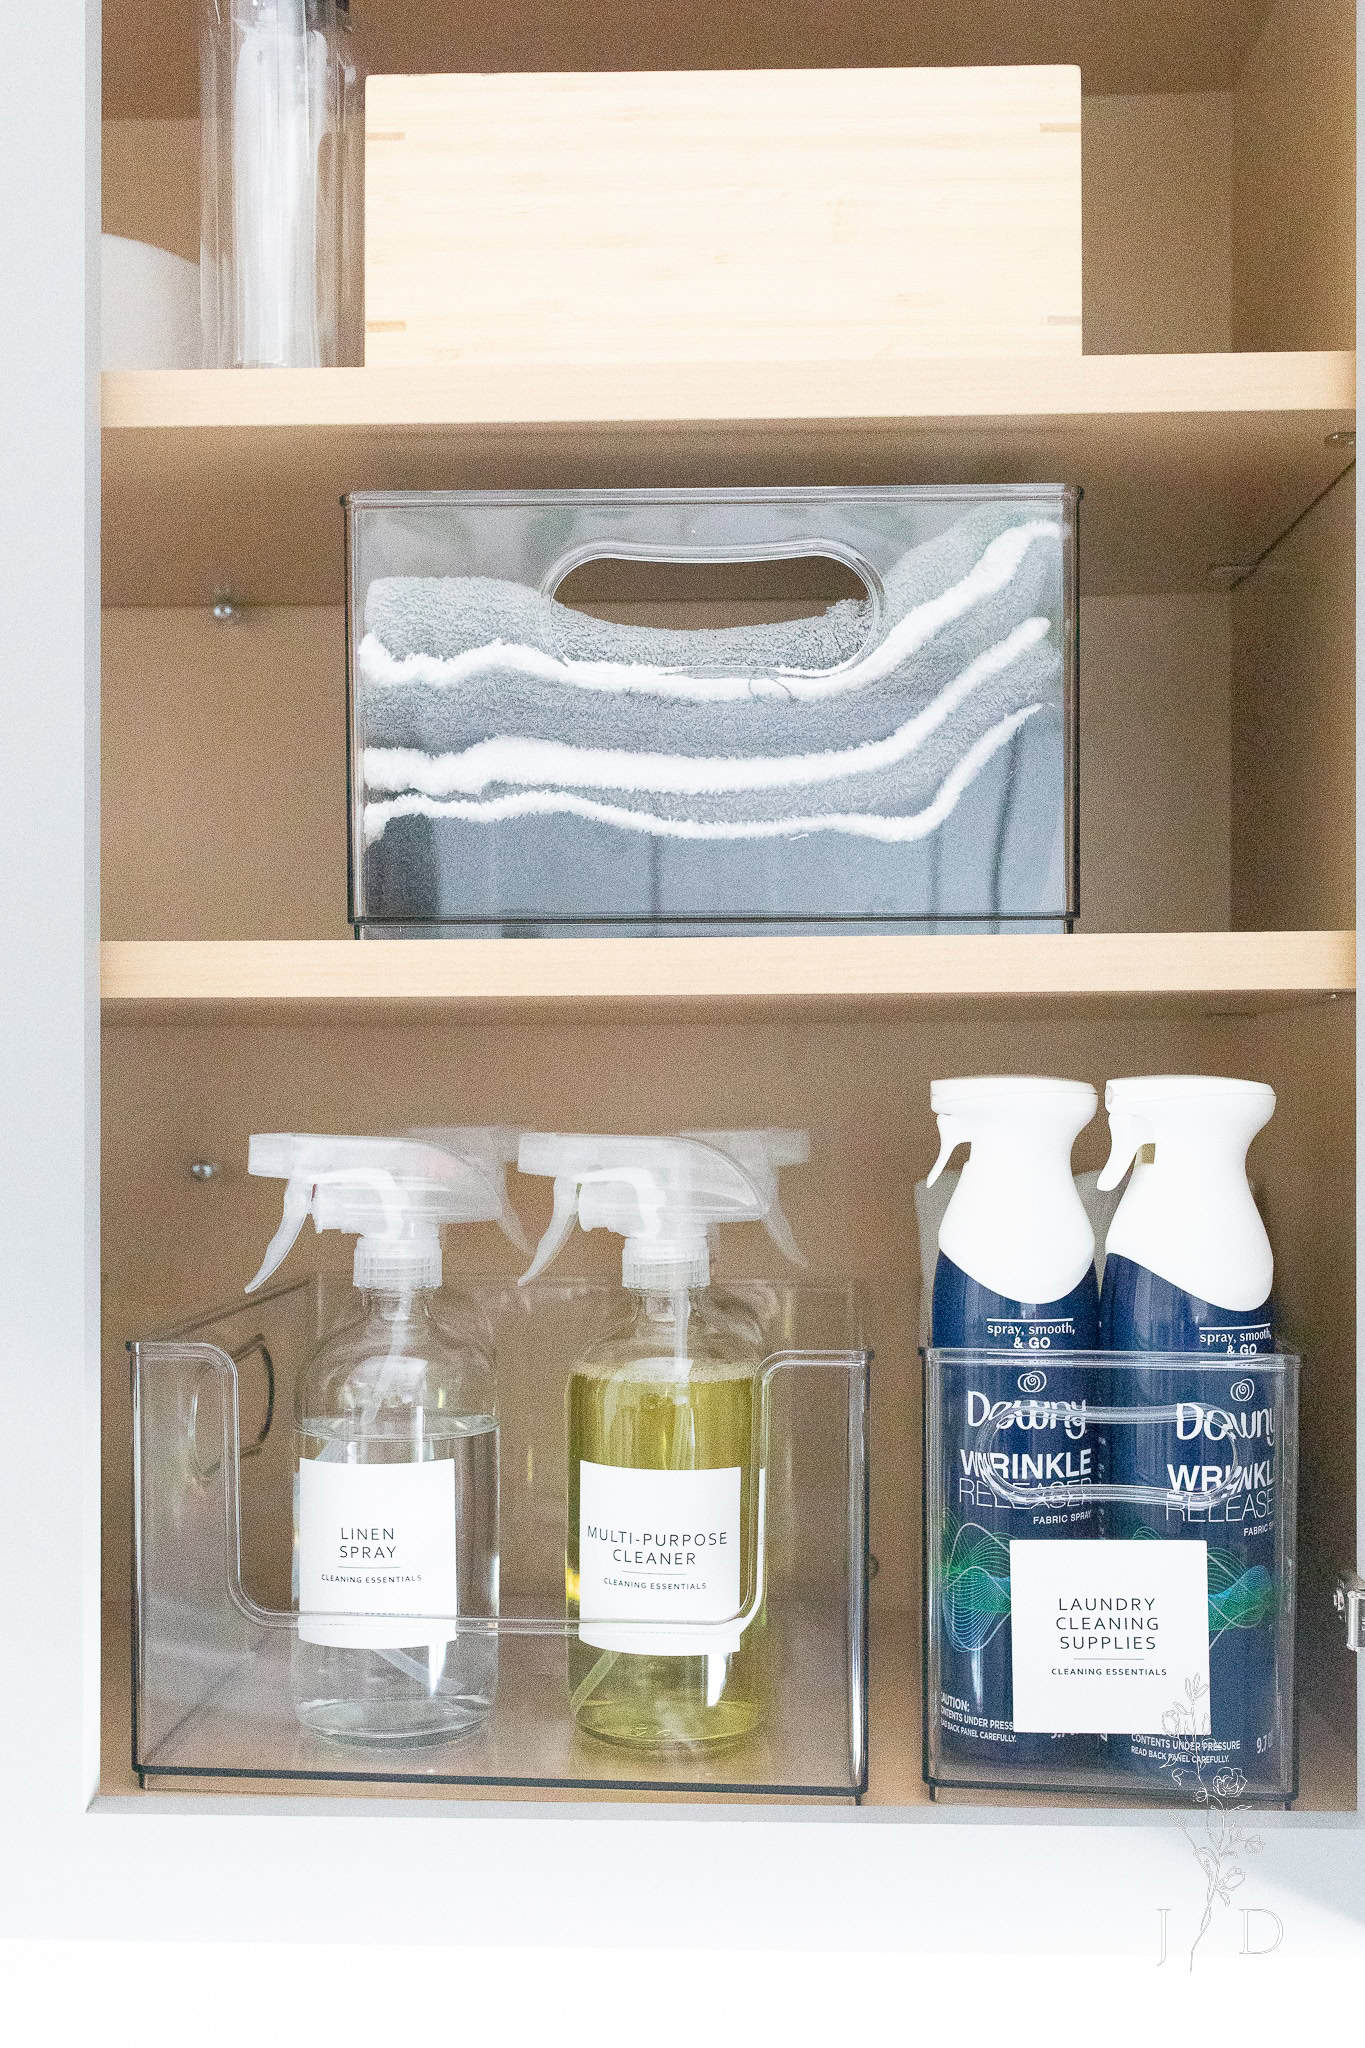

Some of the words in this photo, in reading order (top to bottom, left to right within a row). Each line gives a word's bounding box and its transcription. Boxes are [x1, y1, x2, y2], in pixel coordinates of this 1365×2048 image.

[987, 1324, 1025, 1337] spray,
[1028, 1321, 1075, 1335] smooth,
[1013, 1338, 1023, 1349] &
[1028, 1336, 1051, 1349] GO
[1200, 1333, 1237, 1346] spray,
[1239, 1327, 1272, 1342] smooth,
[1226, 1344, 1235, 1355] &
[1239, 1343, 1257, 1355] GO
[967, 1391, 1087, 1440] Downy
[959, 1448, 1092, 1480] WRINKLE
[1033, 1515, 1068, 1525] FABRIC
[1070, 1509, 1092, 1522] SPRAY
[341, 1527, 394, 1541] LINEN
[587, 1525, 727, 1547] MULTI-PURPOSE
[1243, 1523, 1269, 1537] FABRIC
[339, 1545, 397, 1559] SPRAY
[612, 1549, 696, 1565] CLEANER
[321, 1573, 362, 1583] CLEANING
[365, 1574, 422, 1583] ESSENTIALS
[603, 1577, 647, 1589] CLEANING
[650, 1582, 706, 1590] ESSENTIALS
[1058, 1597, 1156, 1611] LAUNDRY
[1055, 1617, 1160, 1631] CLEANING
[1060, 1636, 1156, 1650] SUPPLIES
[1051, 1668, 1102, 1676] CLEANING
[1106, 1668, 1167, 1676] ESSENTIALS
[941, 1692, 971, 1713] AUTION:
[964, 1714, 988, 1728] UNDER
[960, 1727, 978, 1738] PANEL
[980, 1731, 1017, 1743] CAREFULLY.
[1131, 1733, 1171, 1749] CONTENTS
[1173, 1739, 1200, 1751] UNDER
[1202, 1739, 1241, 1751] PRESSURE
[1131, 1745, 1148, 1757] READ
[1148, 1752, 1167, 1760] BACK
[1168, 1753, 1190, 1763] PANEL
[1191, 1754, 1230, 1764] CAREFULLY.
